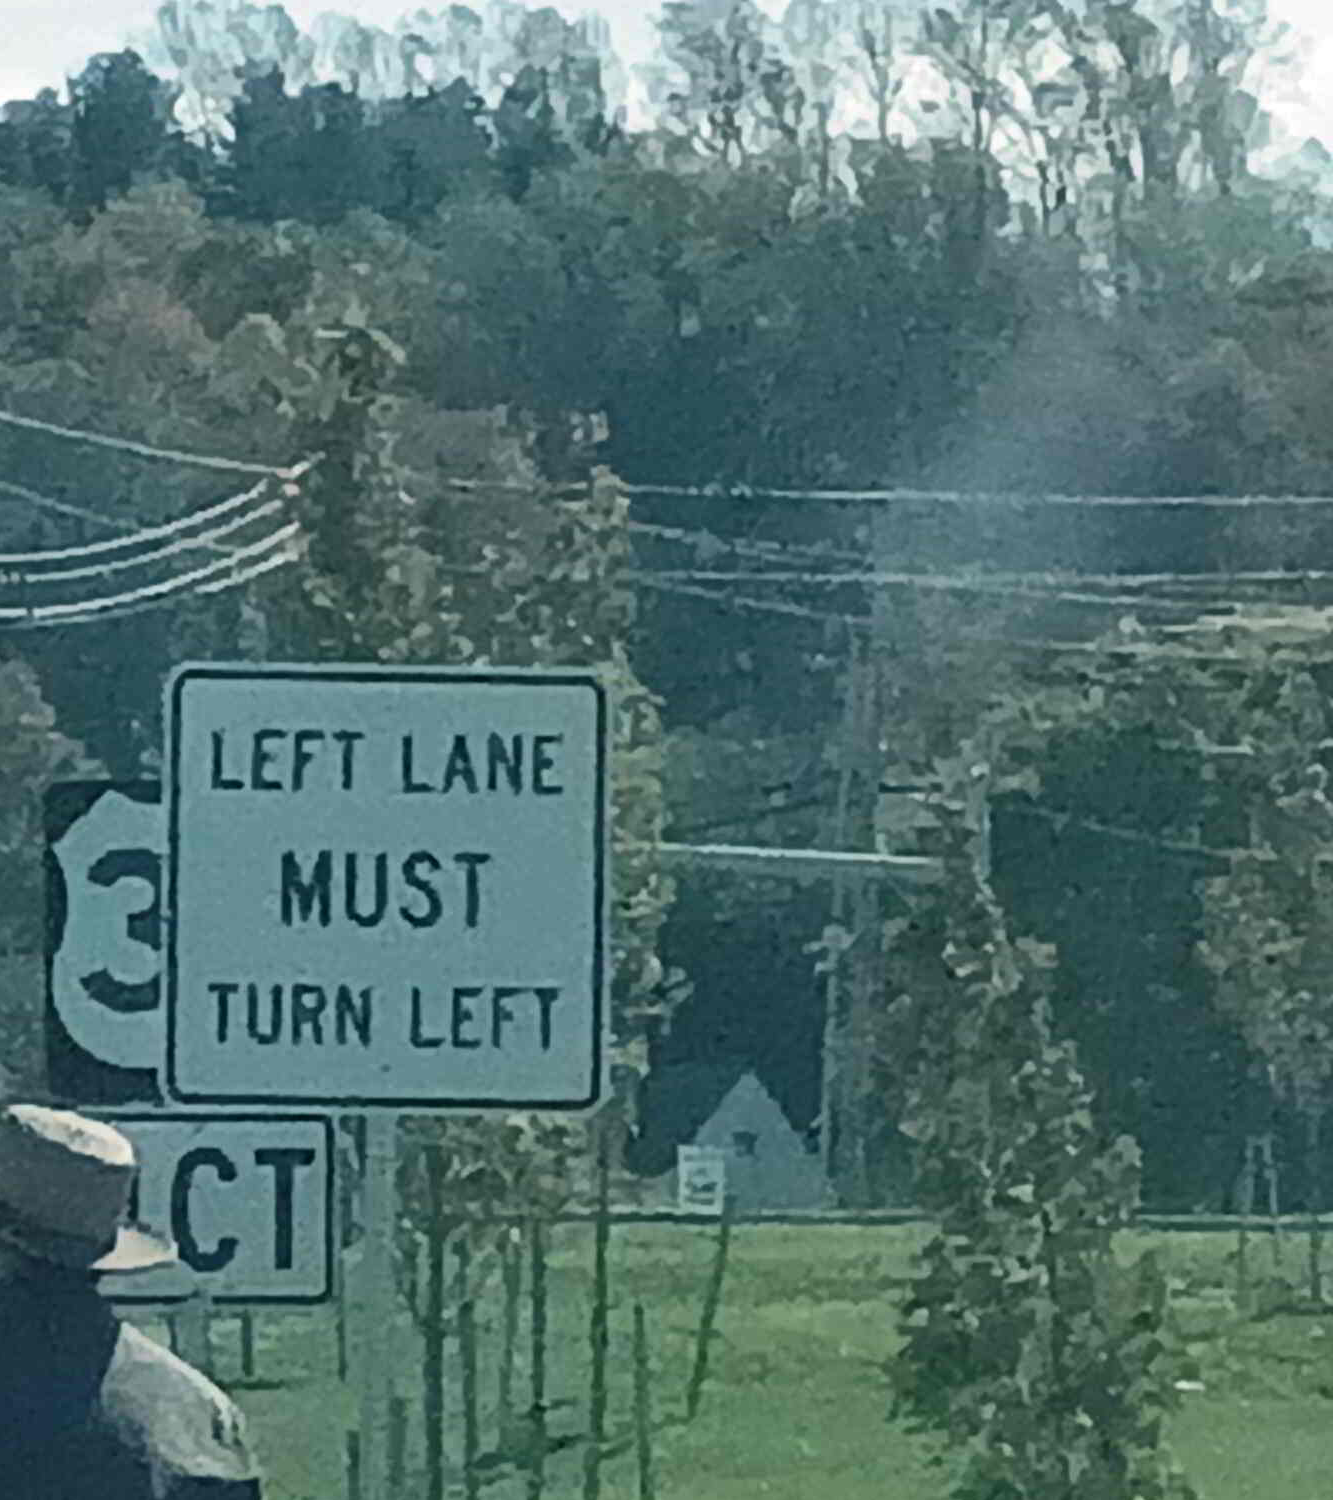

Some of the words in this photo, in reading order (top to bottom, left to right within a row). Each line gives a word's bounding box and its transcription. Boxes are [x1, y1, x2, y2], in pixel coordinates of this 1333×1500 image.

[211, 729, 365, 792] LEFT
[401, 732, 565, 796] LANE
[280, 849, 492, 929] MUST
[79, 848, 163, 1014] 3
[207, 982, 373, 1048] TURN
[409, 985, 563, 1050] LEFT
